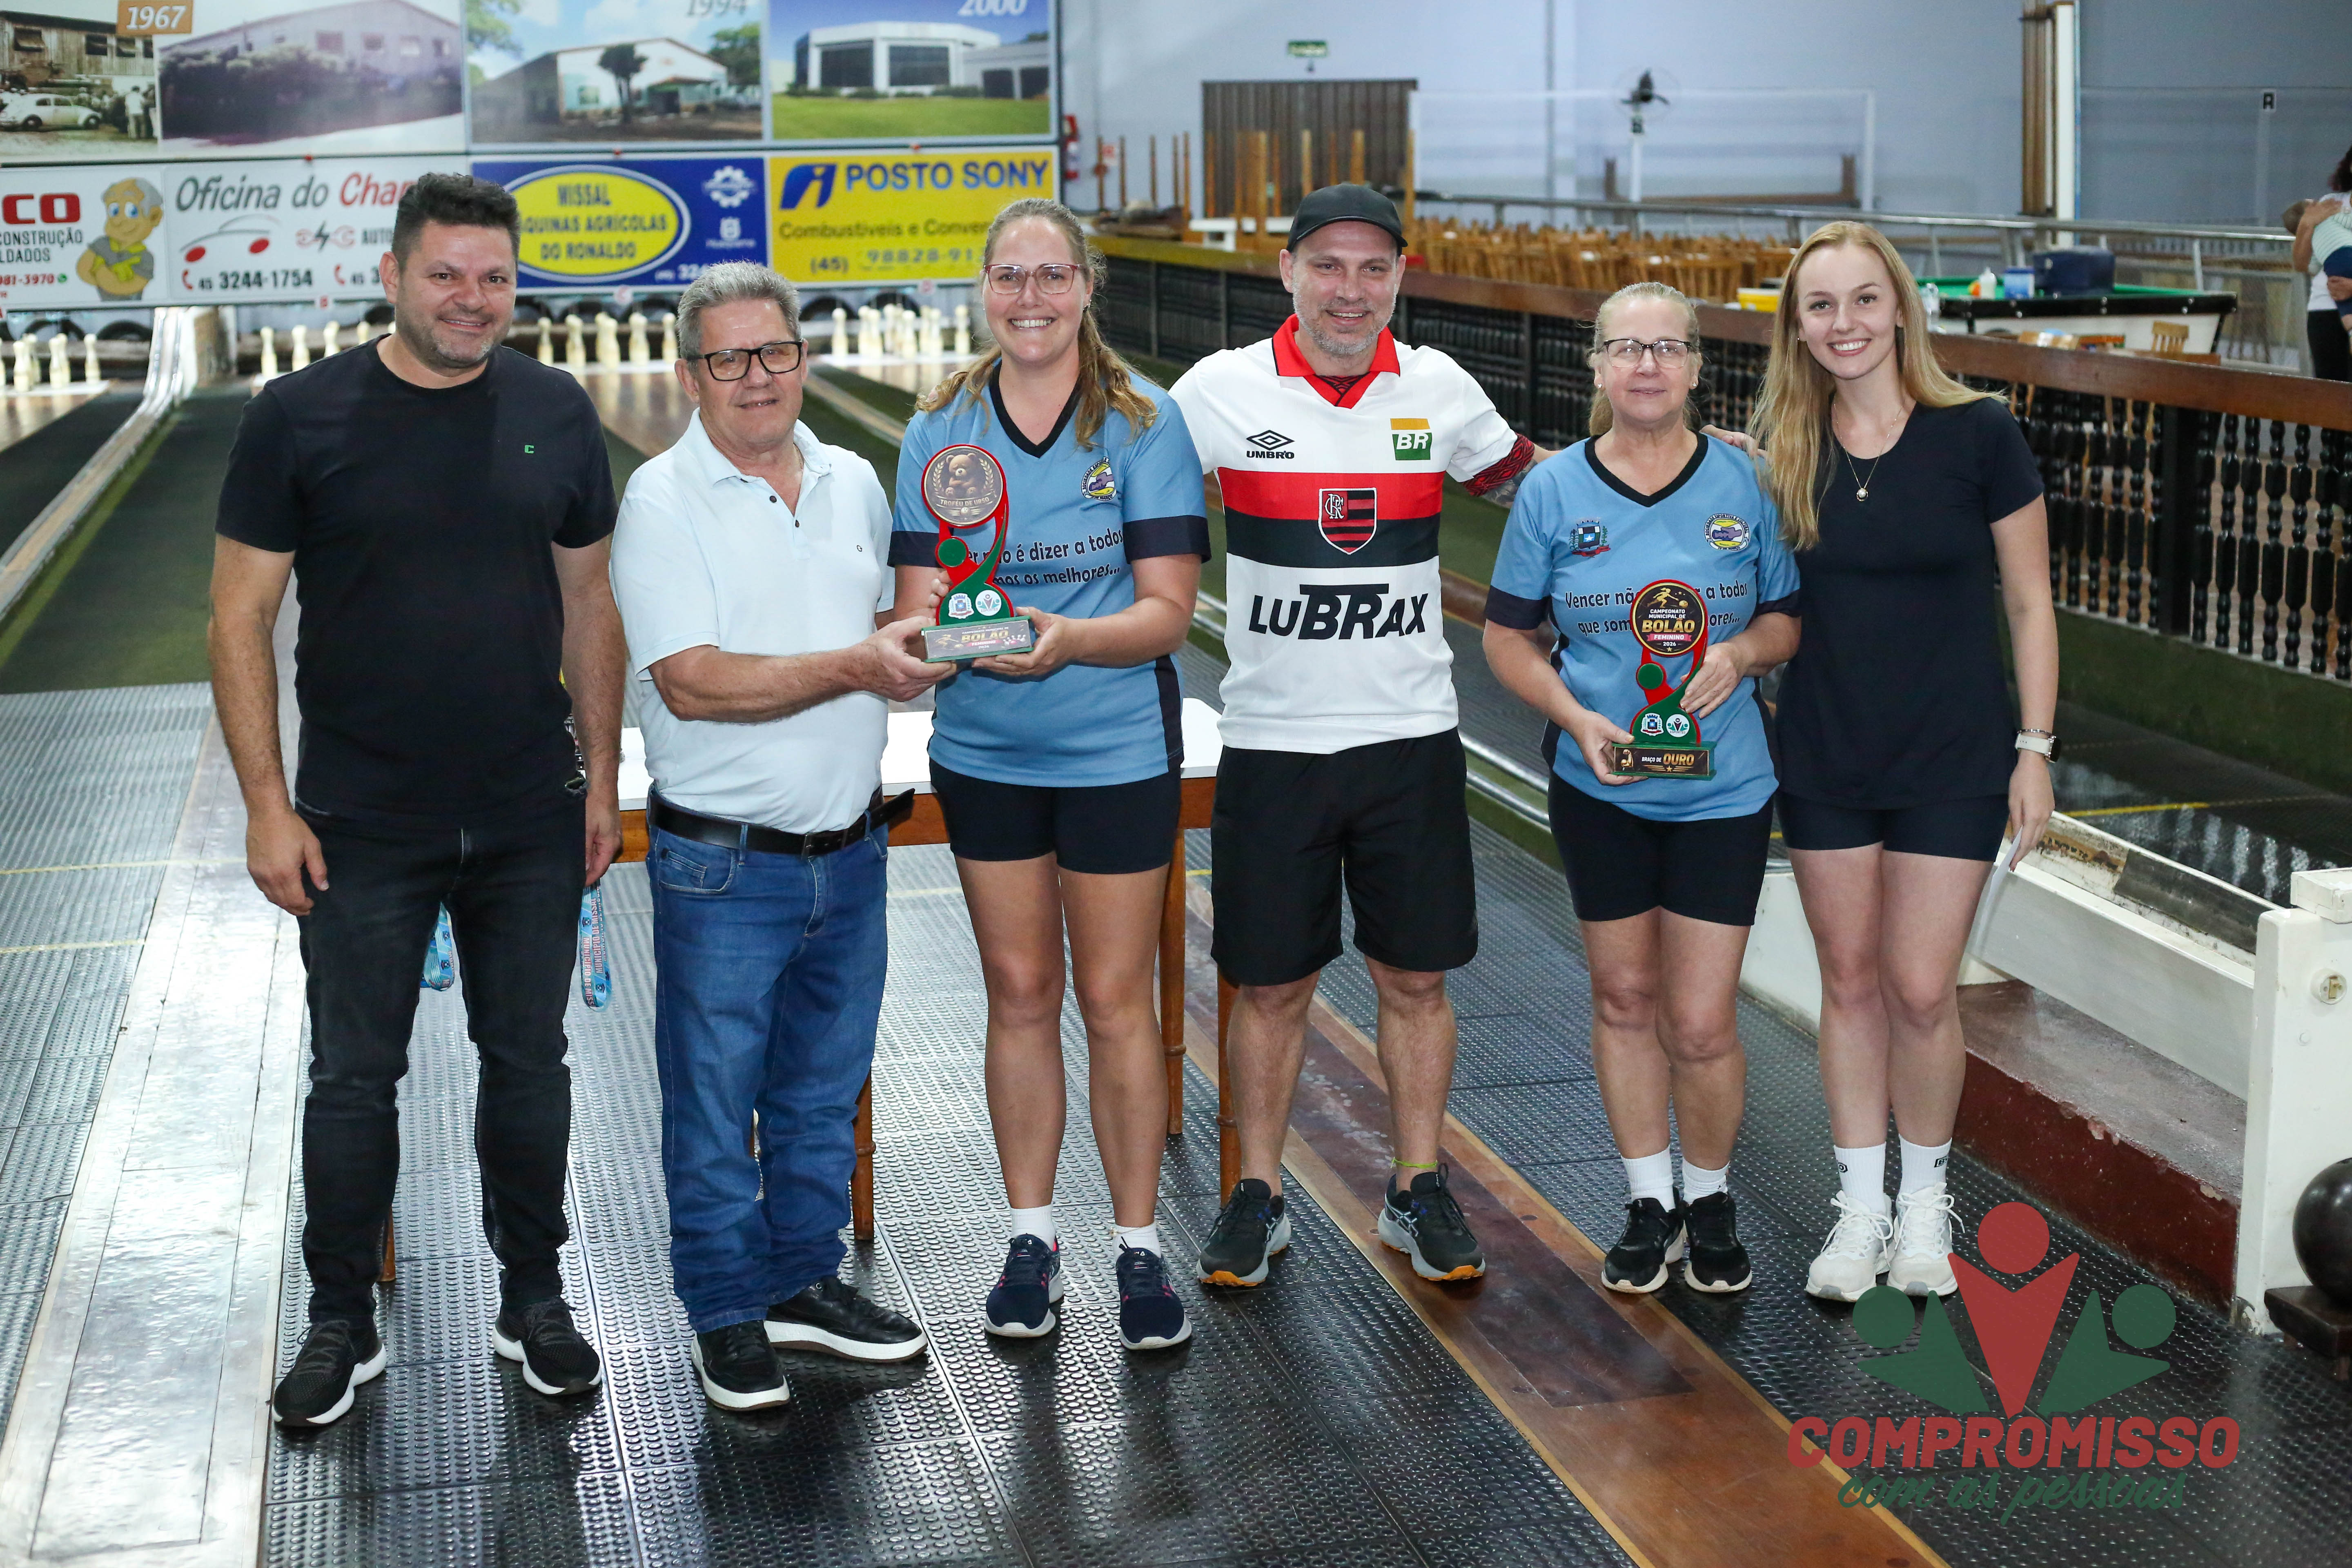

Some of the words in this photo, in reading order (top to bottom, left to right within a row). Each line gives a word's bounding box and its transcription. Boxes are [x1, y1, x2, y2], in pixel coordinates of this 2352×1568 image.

[126, 5, 186, 30] 1967
[845, 163, 953, 192] POSTO
[963, 159, 1049, 190] SONY
[176, 174, 281, 212] Oficina
[291, 175, 329, 209] do
[2, 192, 81, 225] CO
[522, 215, 581, 233] QUINAS
[0, 227, 83, 248] ONSTRUÇÃO
[218, 269, 313, 290] 3244-1754
[1395, 431, 1430, 450] BR
[1246, 450, 1295, 459] UMBRO
[940, 499, 963, 507] TROFÉU
[973, 497, 989, 505] URSO
[1016, 543, 1025, 563] é
[1029, 541, 1069, 562] dizer
[1074, 540, 1086, 555] a
[1088, 527, 1123, 552] todos
[1023, 572, 1039, 585] os
[1043, 563, 1120, 584] melhores...
[1565, 591, 1610, 609] Vencer
[1615, 586, 1638, 606] nã
[1706, 586, 1716, 600] a
[1719, 579, 1747, 599] todos
[1248, 583, 1429, 640] LUBRAX
[1577, 621, 1601, 637] que
[1707, 612, 1740, 628] ores...
[1642, 618, 1695, 633] BOLÃO
[1663, 753, 1695, 766] OURO
[592, 925, 600, 935] DE
[584, 978, 592, 987] DE
